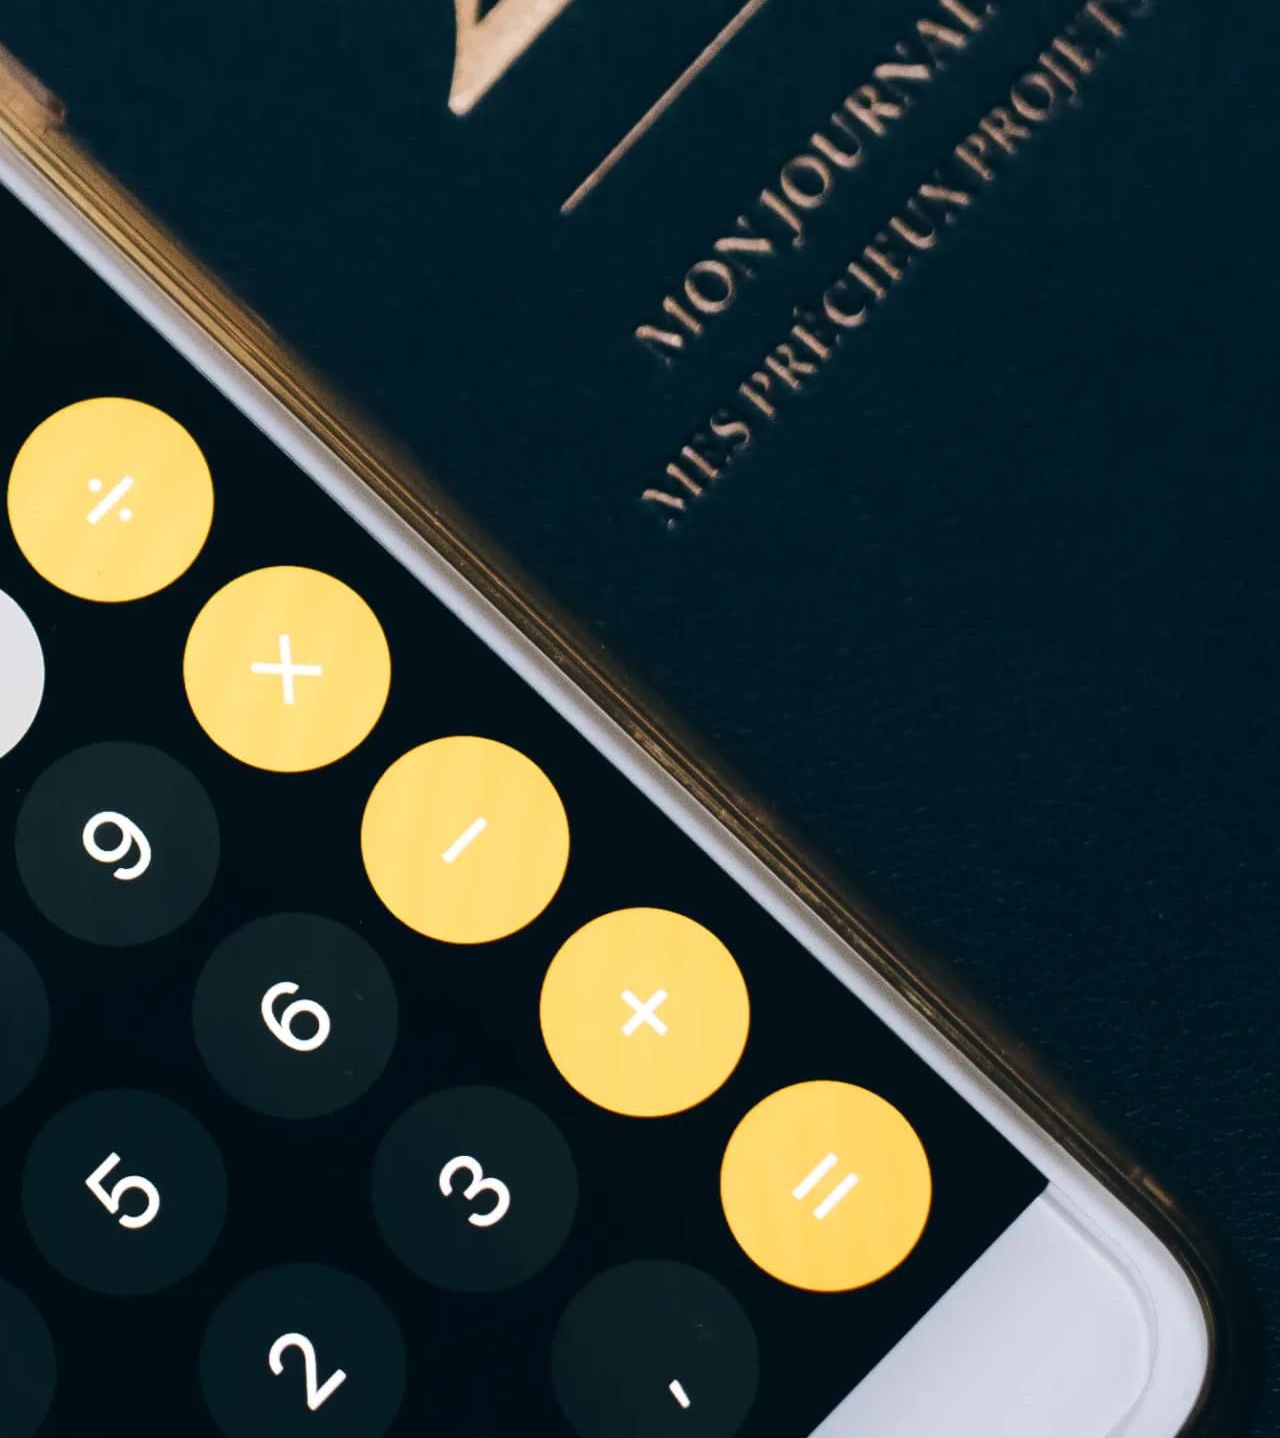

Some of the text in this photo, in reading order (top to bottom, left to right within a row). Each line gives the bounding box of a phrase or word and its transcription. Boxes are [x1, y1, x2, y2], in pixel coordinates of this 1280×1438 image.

[634, 215, 774, 367] MON
[642, 408, 752, 529] MES
[737, 170, 971, 422] PRÉCIEUX
[83, 812, 151, 880] 9
[86, 1152, 160, 1228] 5
[261, 982, 330, 1051] 6
[269, 1333, 346, 1410] 2
[439, 1156, 510, 1226] 3
